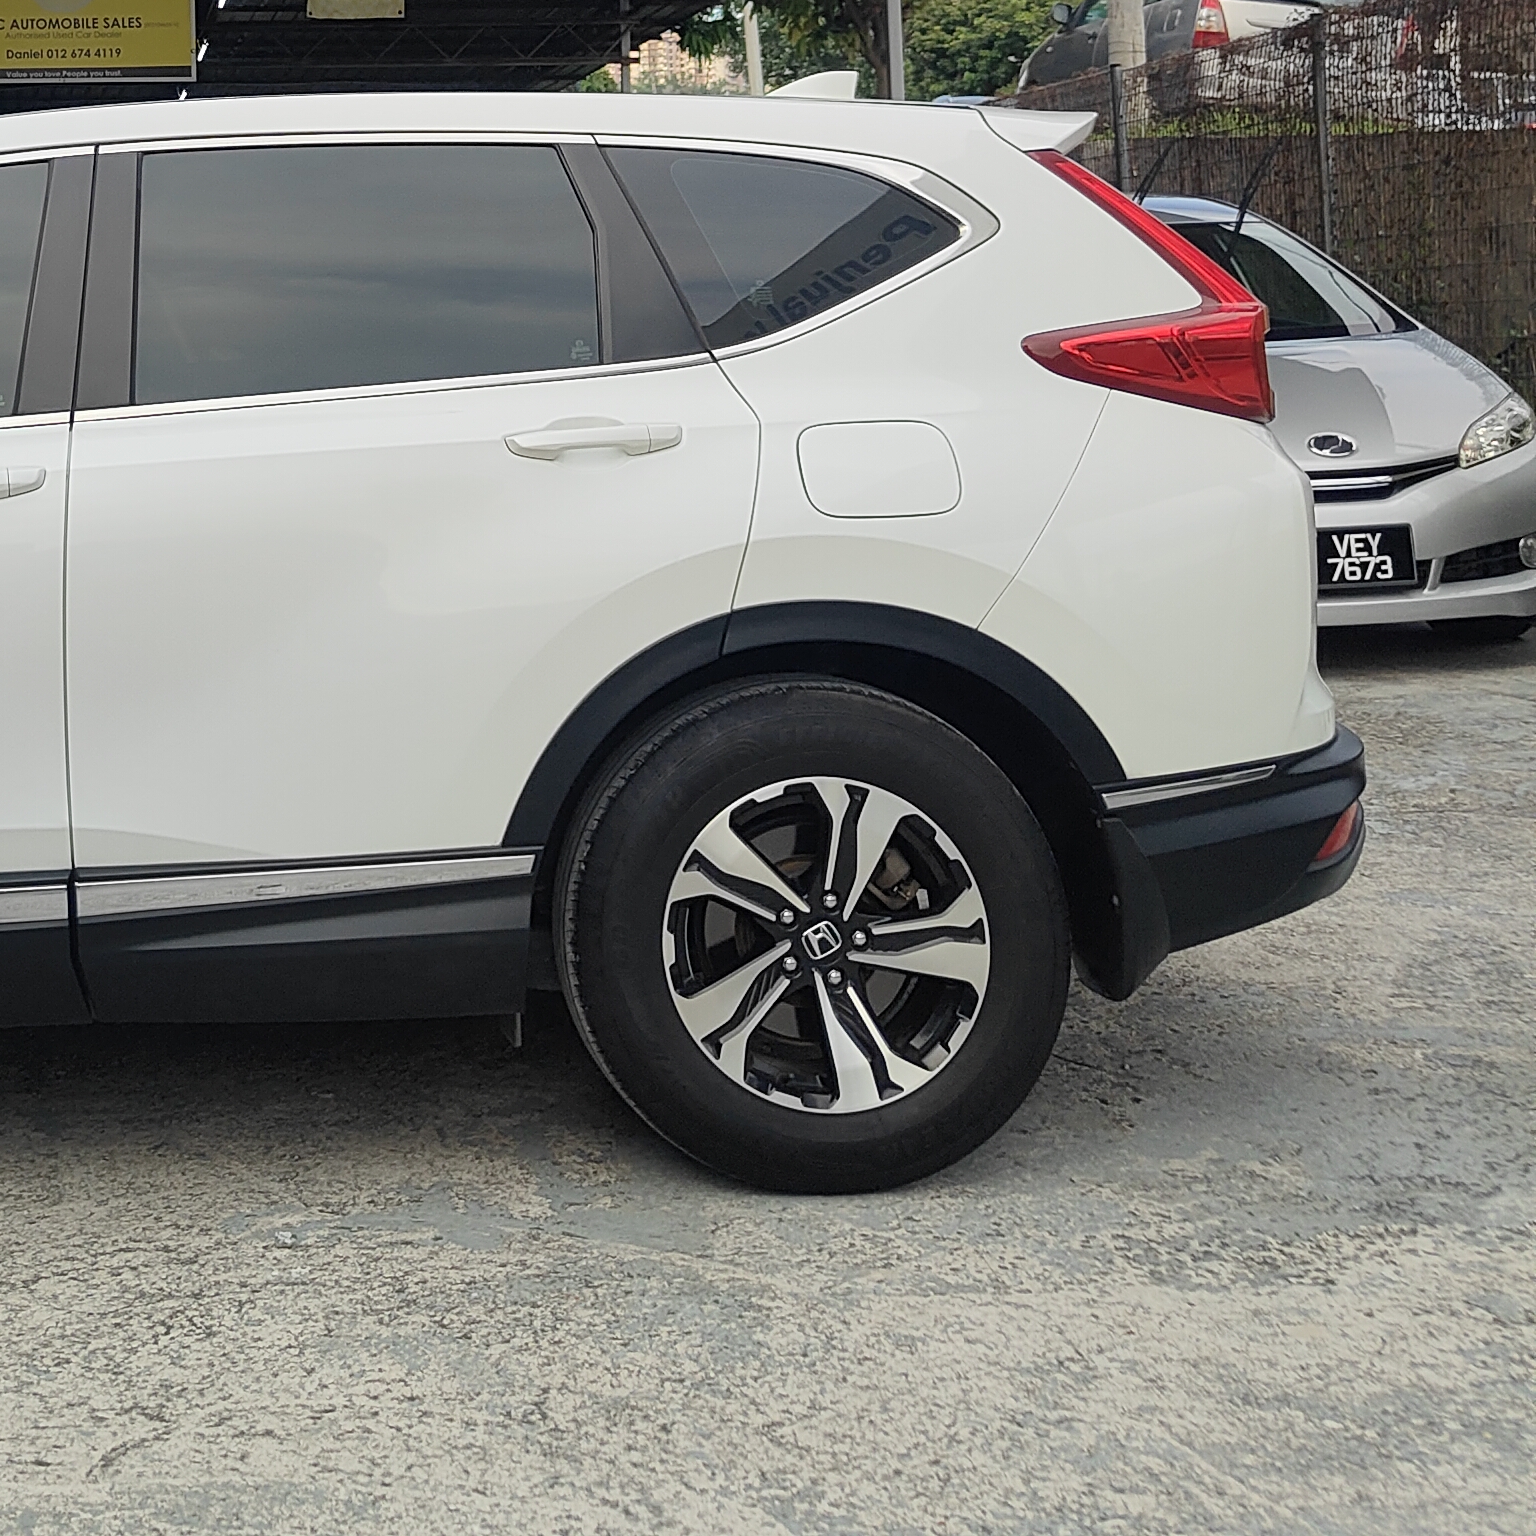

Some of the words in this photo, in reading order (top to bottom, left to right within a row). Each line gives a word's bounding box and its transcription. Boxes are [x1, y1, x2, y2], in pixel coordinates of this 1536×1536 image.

[9, 17, 99, 30] AUTOMOBILE
[103, 16, 142, 29] SALES
[75, 30, 91, 38] Car
[93, 30, 122, 38] Dealer
[6, 49, 44, 60] Daniel
[46, 49, 68, 59] 012
[70, 48, 91, 59] 674
[93, 47, 122, 59] 4119
[6, 71, 28, 79] Value
[29, 71, 44, 79] you
[89, 70, 105, 78] you
[1331, 532, 1382, 557] VEY
[1326, 555, 1394, 582] 7673
